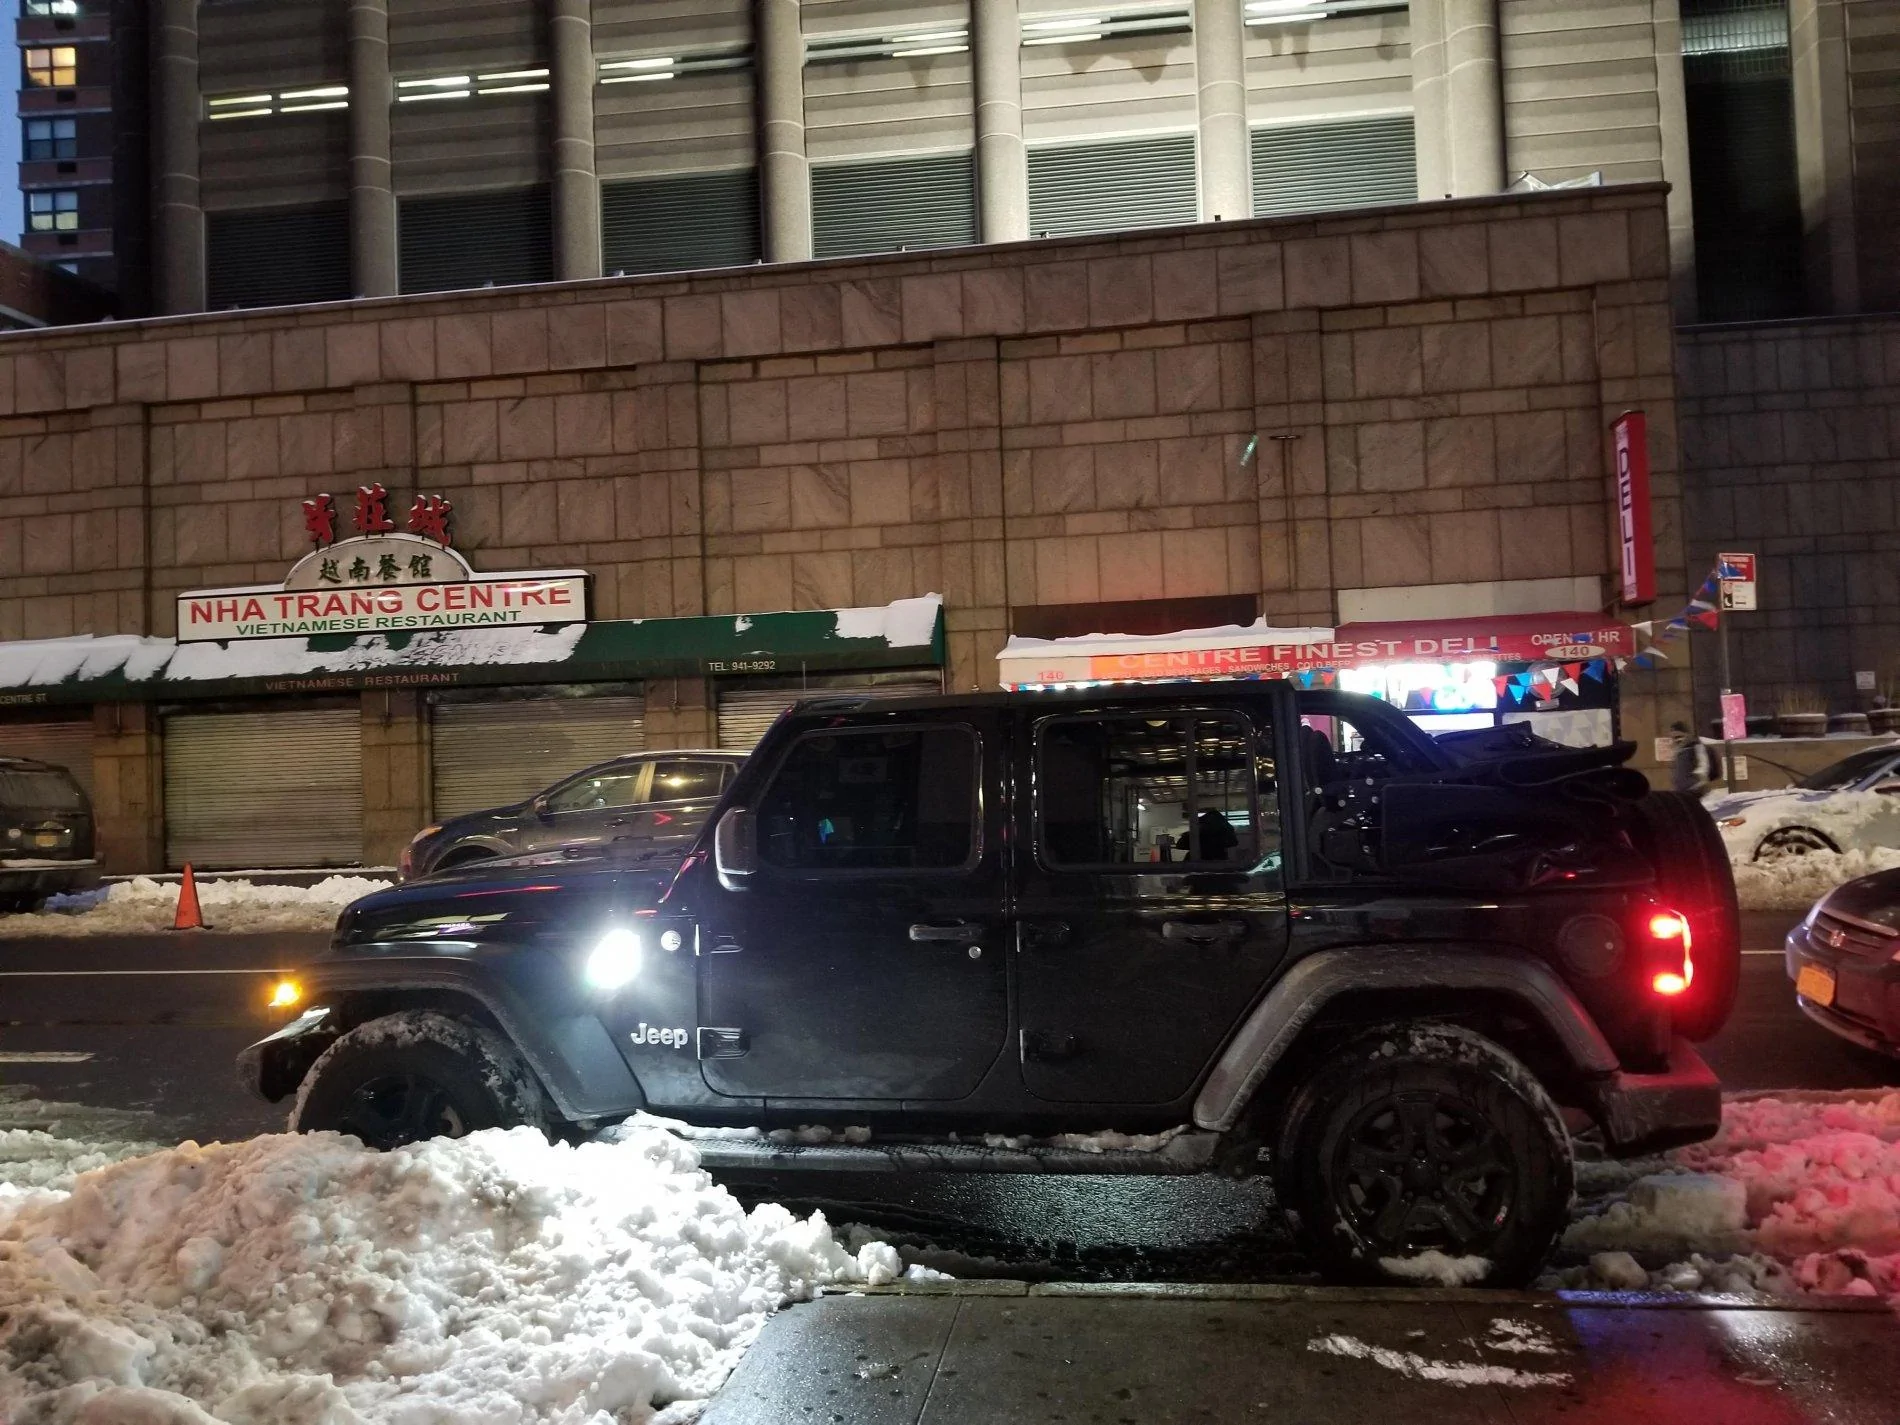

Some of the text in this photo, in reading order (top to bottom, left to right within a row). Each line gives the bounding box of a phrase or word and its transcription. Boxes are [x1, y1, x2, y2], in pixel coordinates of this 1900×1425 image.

[1619, 447, 1633, 577] DELI
[319, 553, 434, 583] 越南餐館
[190, 582, 572, 624] NHA TRANG CENTRE
[236, 610, 522, 635] VIETNAMESE RESTAURANT
[1531, 633, 1573, 645] OPEN
[1598, 631, 1620, 643] HR
[1118, 647, 1262, 669] CENTRE
[1273, 641, 1402, 661] FINEST
[1414, 636, 1498, 655] DELI
[1560, 646, 1589, 657] 140
[732, 661, 776, 671] 941-9292
[1038, 671, 1064, 680] 140
[1228, 663, 1290, 673] SANDWICHES
[265, 673, 460, 691] VIETNAMESE RESTAURANT
[630, 1022, 689, 1049] Jeep
